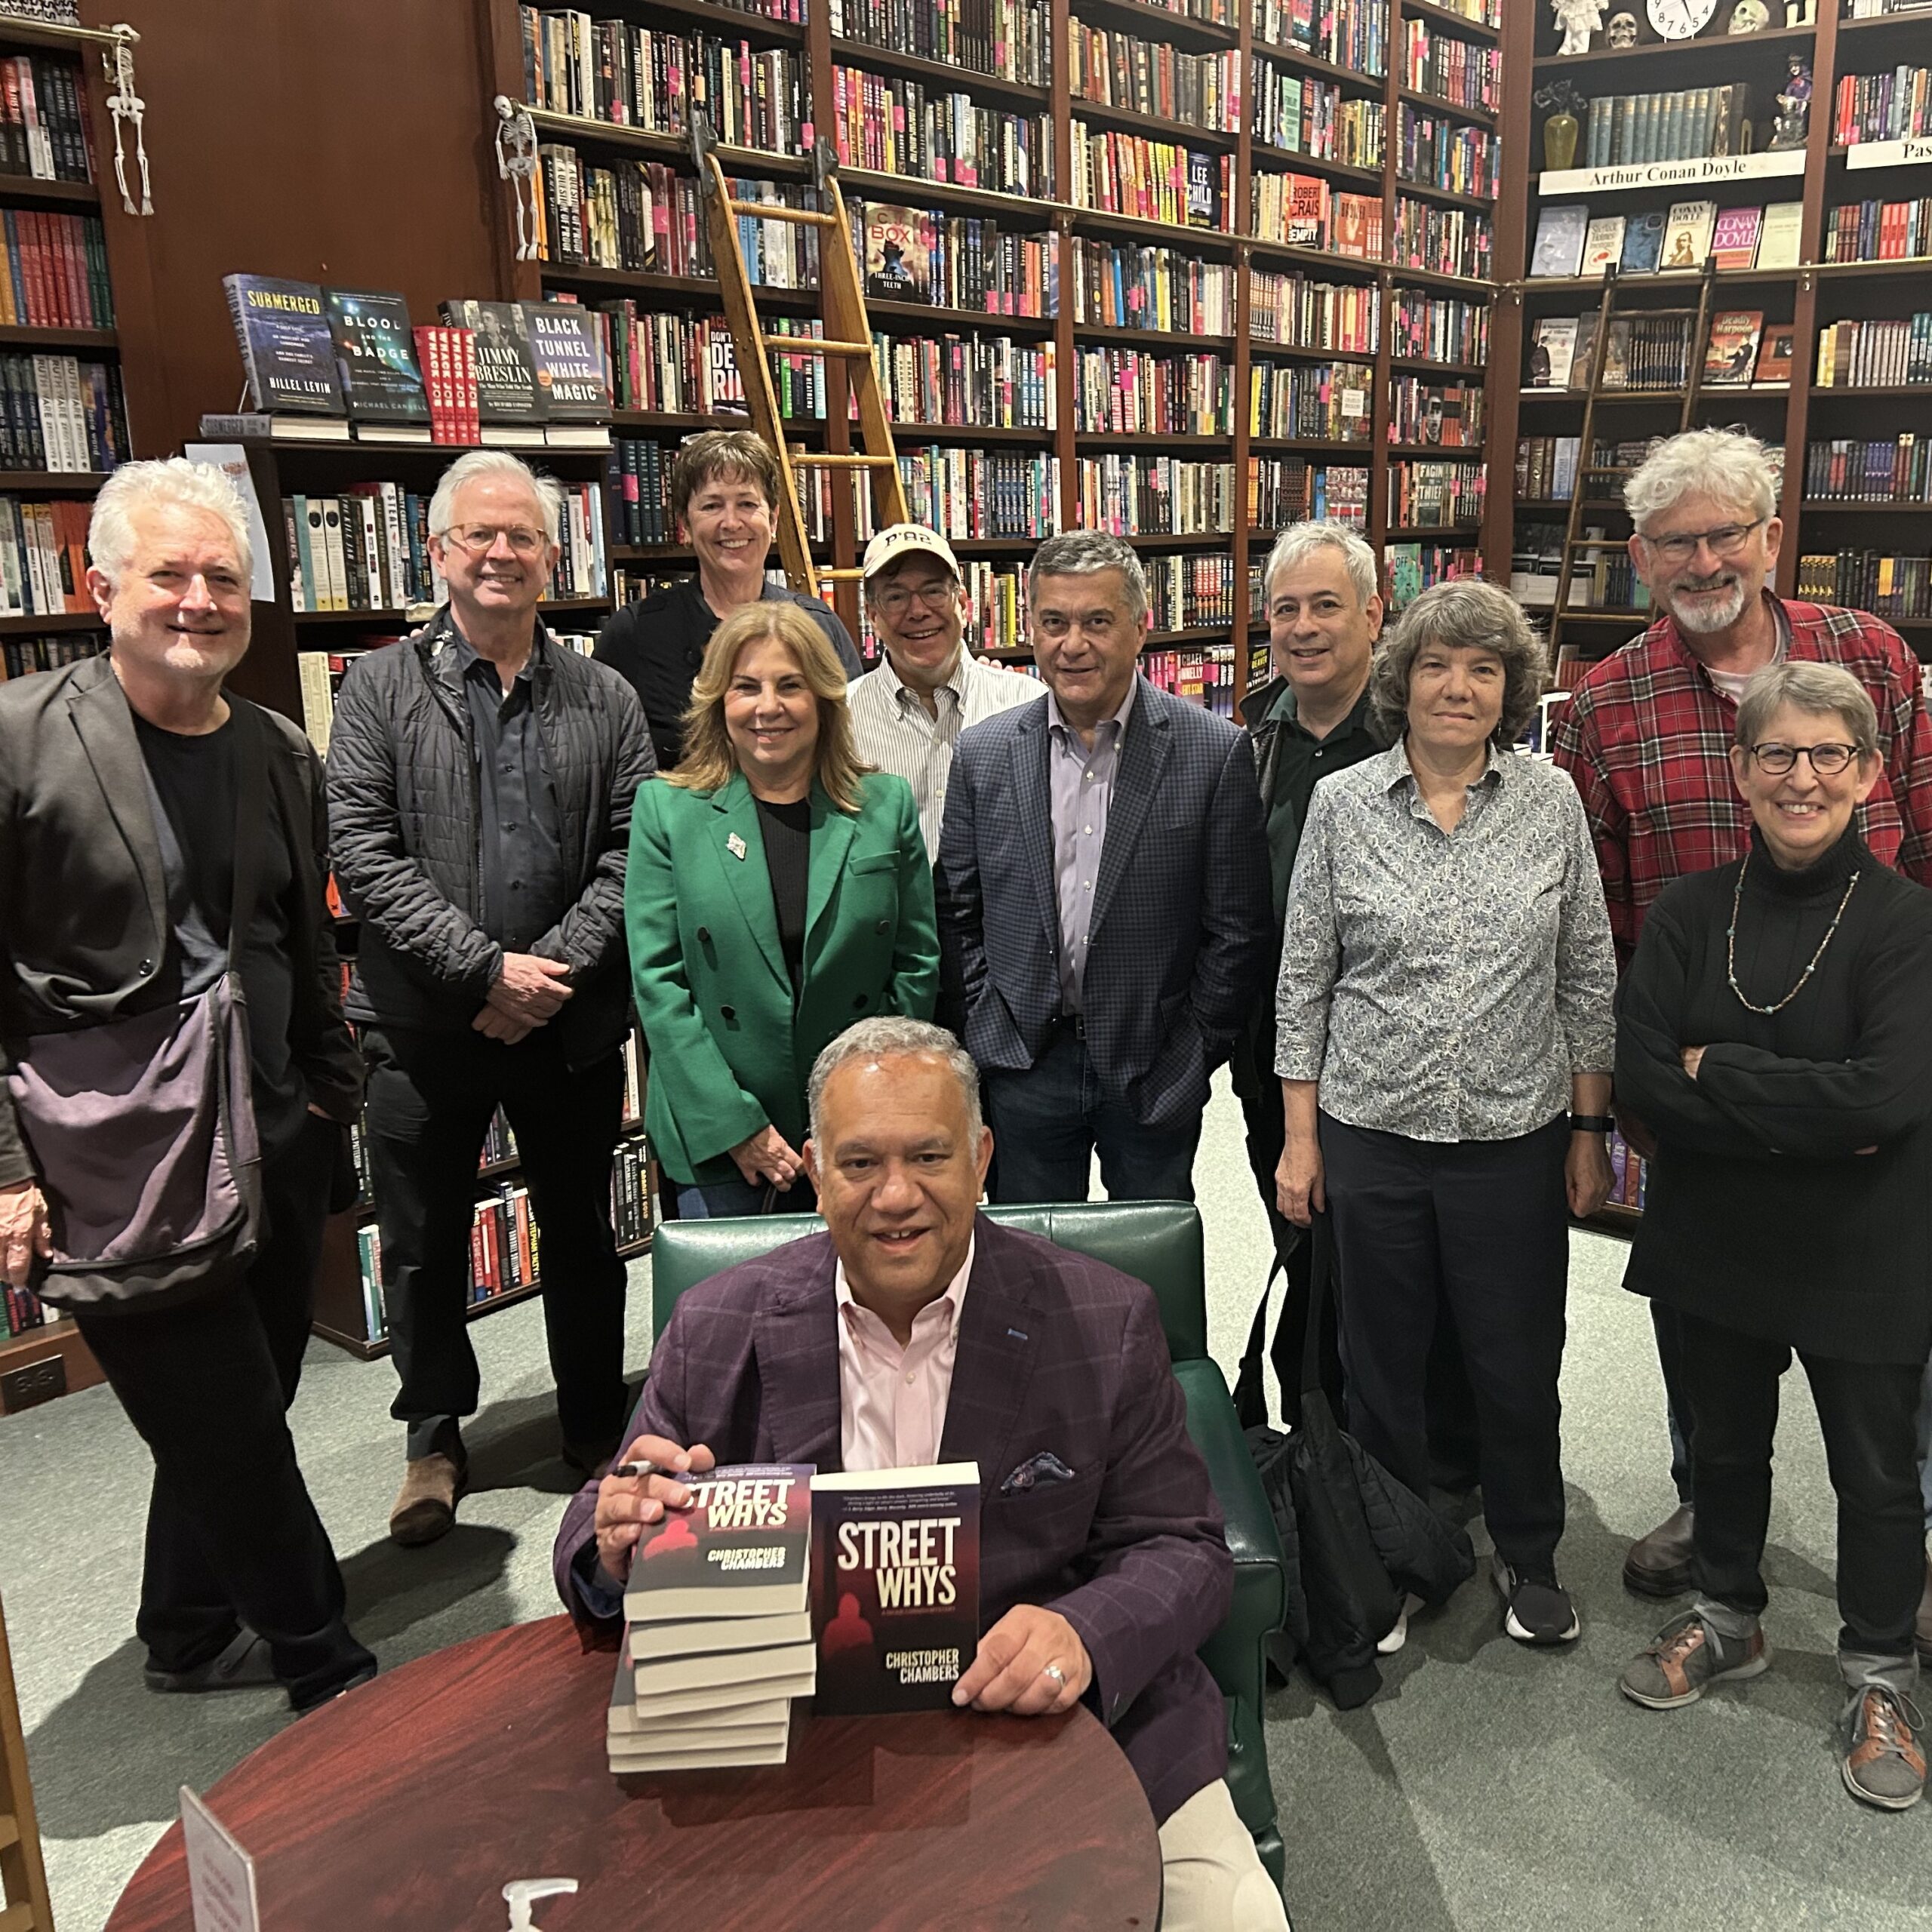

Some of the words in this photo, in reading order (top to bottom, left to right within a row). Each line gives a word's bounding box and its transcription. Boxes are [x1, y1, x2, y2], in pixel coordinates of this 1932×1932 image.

[1658, 12, 1665, 23] 8
[1703, 5, 1709, 15] 4
[1667, 20, 1675, 32] 7
[1679, 23, 1687, 33] 6
[1692, 17, 1699, 28] 5
[1903, 143, 1932, 158] Pas
[1192, 165, 1208, 185] LEE
[1590, 171, 1642, 186] Arthur
[1647, 166, 1696, 181] Conan
[1703, 160, 1746, 177] Doyle
[558, 174, 568, 211] QUESTION
[570, 177, 580, 213] QUESTION
[1188, 183, 1213, 204] CHILD
[1293, 187, 1321, 198] ROBERT
[1291, 200, 1319, 217] CRAIS
[1672, 205, 1704, 214] CONAN
[1672, 213, 1703, 222] DOYLE
[559, 214, 568, 225] OF
[571, 215, 580, 226] OF
[1717, 216, 1758, 231] CONAN
[561, 226, 571, 252] PROOF
[573, 227, 582, 254] PROOF
[871, 225, 912, 244] BOX
[1290, 228, 1318, 242] EMPTY
[1713, 230, 1755, 248] DOYLE
[883, 279, 902, 290] TEETH
[248, 290, 320, 315] SUBMERGED
[225, 284, 249, 361] SUBMERGED
[535, 318, 582, 335] BLACK
[1716, 324, 1754, 334] Harpoon
[1721, 315, 1752, 325] Deadly
[352, 346, 409, 359] BADGE
[428, 331, 438, 378] WHACK
[439, 332, 451, 378] WHACK
[452, 333, 463, 379] WHACK
[465, 334, 475, 380] WHACK
[478, 347, 520, 365] JIMMY
[536, 340, 591, 358] TUNNEL
[37, 358, 48, 387] RUTH
[52, 359, 63, 388] RUTH
[68, 361, 77, 389] RUTH
[475, 365, 531, 383] BRESLIN
[546, 361, 592, 378] WHITE
[269, 377, 301, 391] HILLEL
[304, 381, 331, 394] LEVIN
[432, 382, 441, 407] JOB
[443, 383, 453, 408] JOB
[456, 383, 465, 408] JOB
[552, 384, 597, 401] MAGIC
[42, 390, 52, 418] WARE
[57, 390, 66, 418] WARE
[71, 392, 82, 420] WARE
[353, 401, 389, 410] MICHAEL
[468, 384, 478, 408] JOB
[1125, 391, 1134, 429] ECEPTION
[92, 433, 100, 456] wand
[628, 446, 636, 472] FIRST
[1420, 465, 1443, 478] FAGIN
[1419, 486, 1442, 500] THIEF
[388, 495, 397, 528] STEAL
[343, 517, 352, 539] KILL
[400, 509, 408, 544] CREATURES
[561, 503, 569, 543] PARKLAND
[1182, 653, 1203, 665] CHAEL
[1251, 657, 1268, 669] DEAVER
[352, 1141, 361, 1169] PATTERSON
[529, 1221, 538, 1253] STEPHAN
[708, 1503, 788, 1527] WHYS
[707, 1546, 786, 1561] CHRISTOPHER
[837, 1517, 961, 1571] STREET
[721, 1556, 785, 1571] CHAMBERS
[875, 1565, 956, 1608] WHYS
[885, 1647, 960, 1670] CHRISTOPHER
[900, 1664, 960, 1684] CHAMBERS
